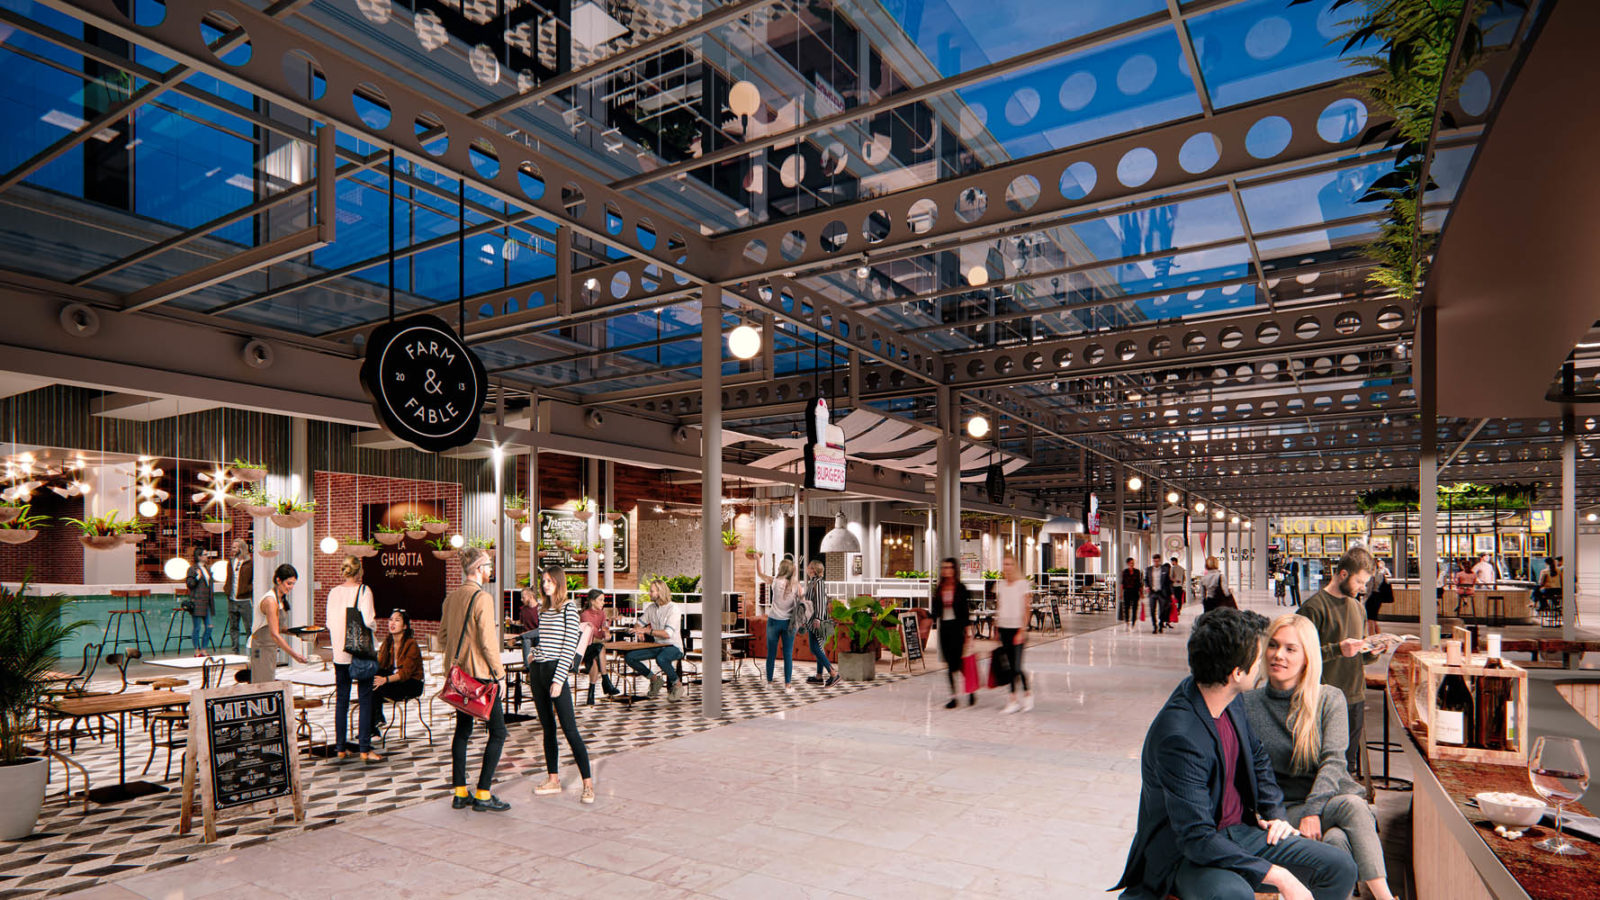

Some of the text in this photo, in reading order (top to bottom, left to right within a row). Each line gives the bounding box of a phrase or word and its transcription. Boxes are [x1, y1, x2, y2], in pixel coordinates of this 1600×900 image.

[405, 341, 455, 366] FARM
[395, 368, 466, 395] 20 & 13
[404, 397, 459, 424] FABLE
[816, 465, 845, 483] BURGERS
[1283, 517, 1309, 533] UCI
[398, 541, 406, 550] LA
[381, 552, 424, 567] GHIOTTA
[214, 697, 277, 721] MENU
